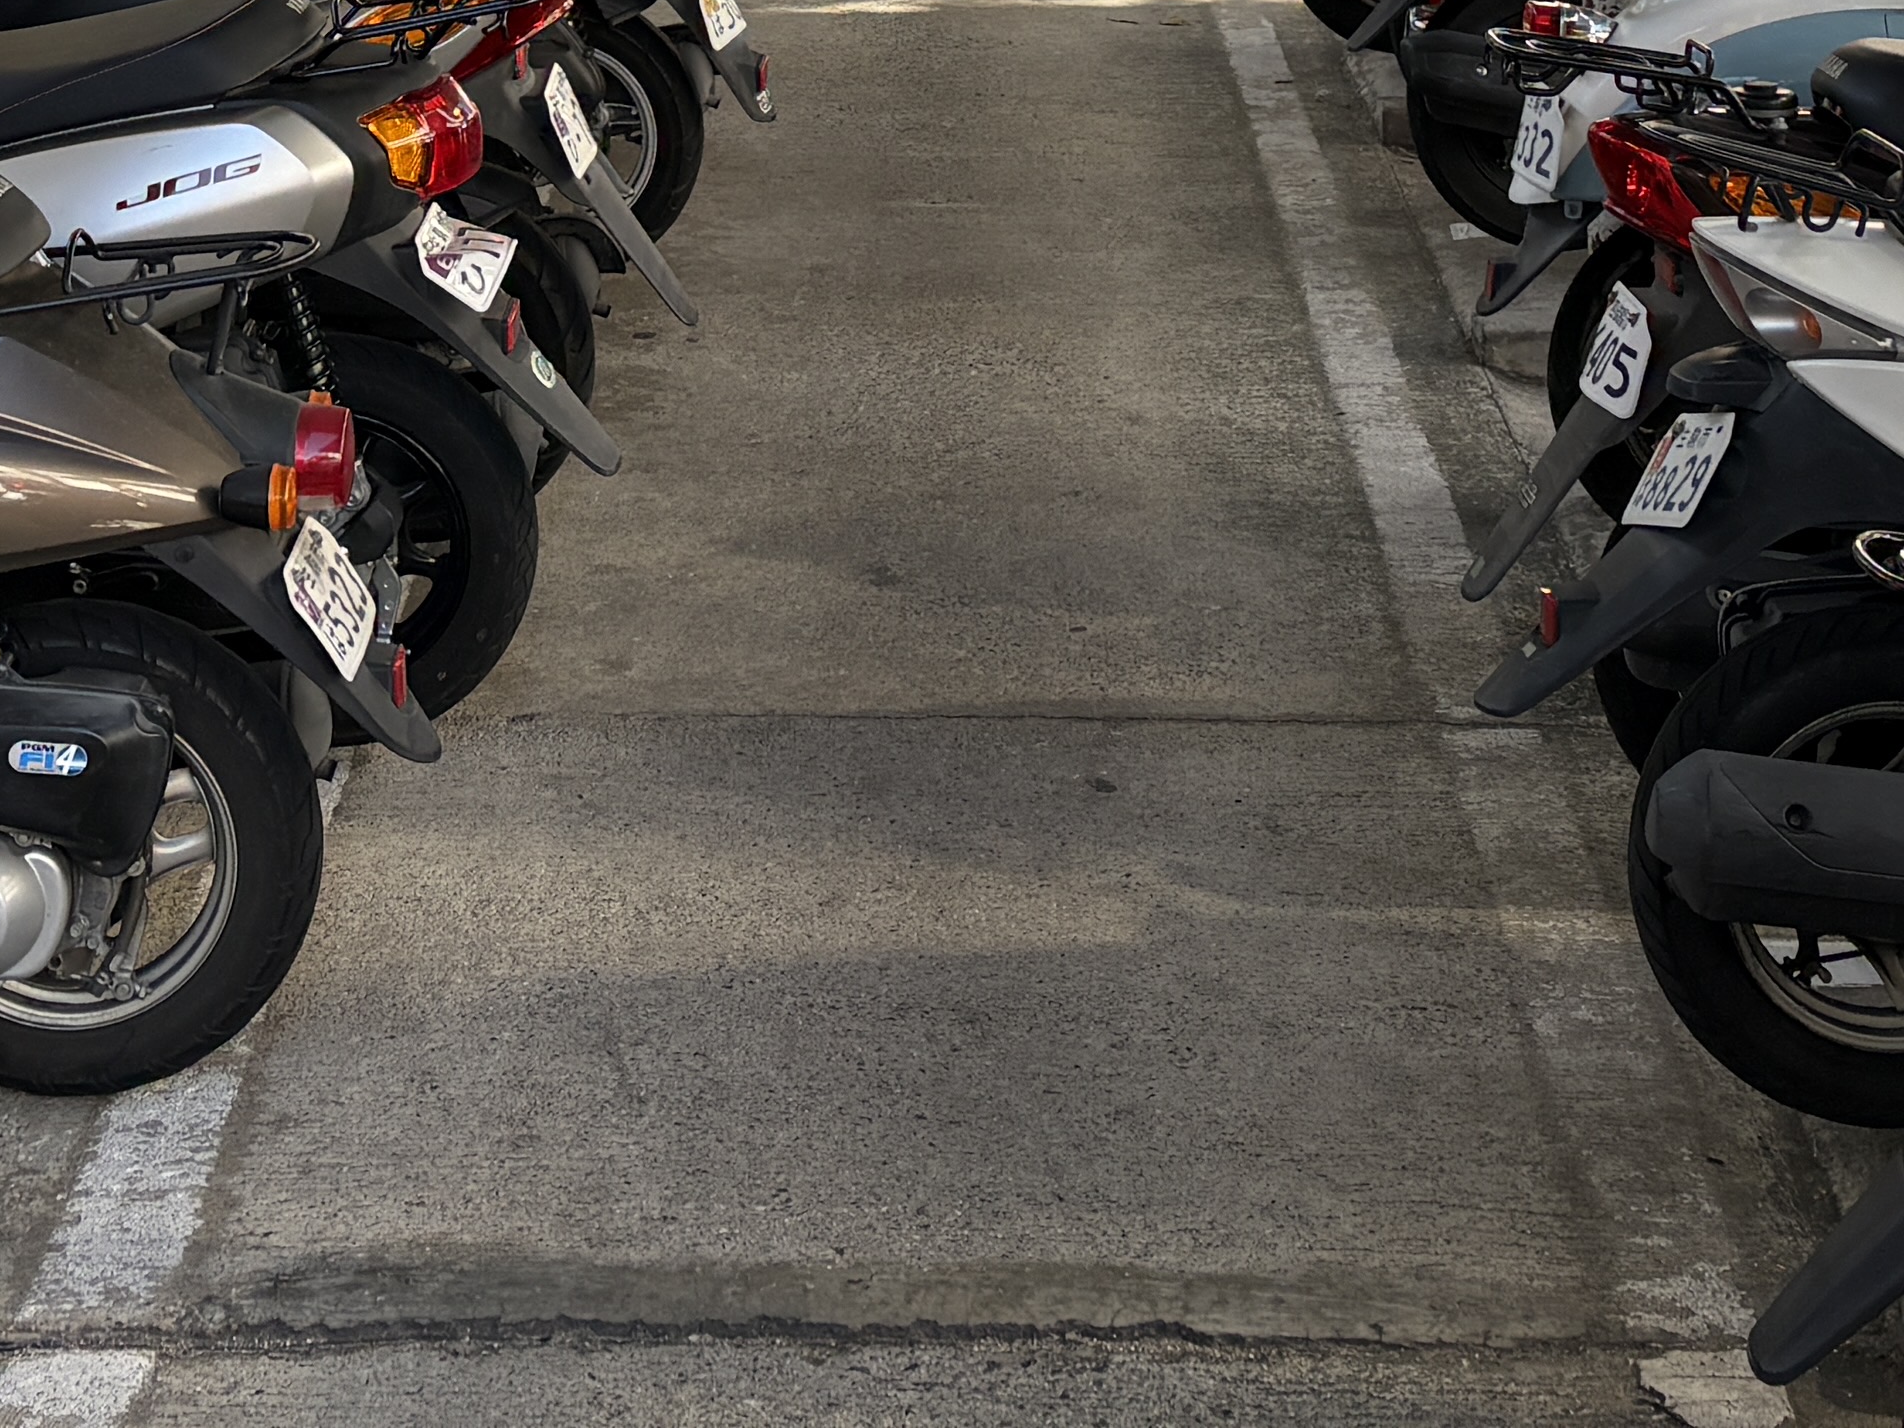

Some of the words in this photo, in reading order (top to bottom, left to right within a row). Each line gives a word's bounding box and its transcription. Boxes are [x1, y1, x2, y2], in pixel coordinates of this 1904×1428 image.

[116, 152, 263, 211] JOG
[1641, 453, 1712, 513] 8829
[315, 549, 371, 654] 5323
[20, 742, 55, 753] PGM
